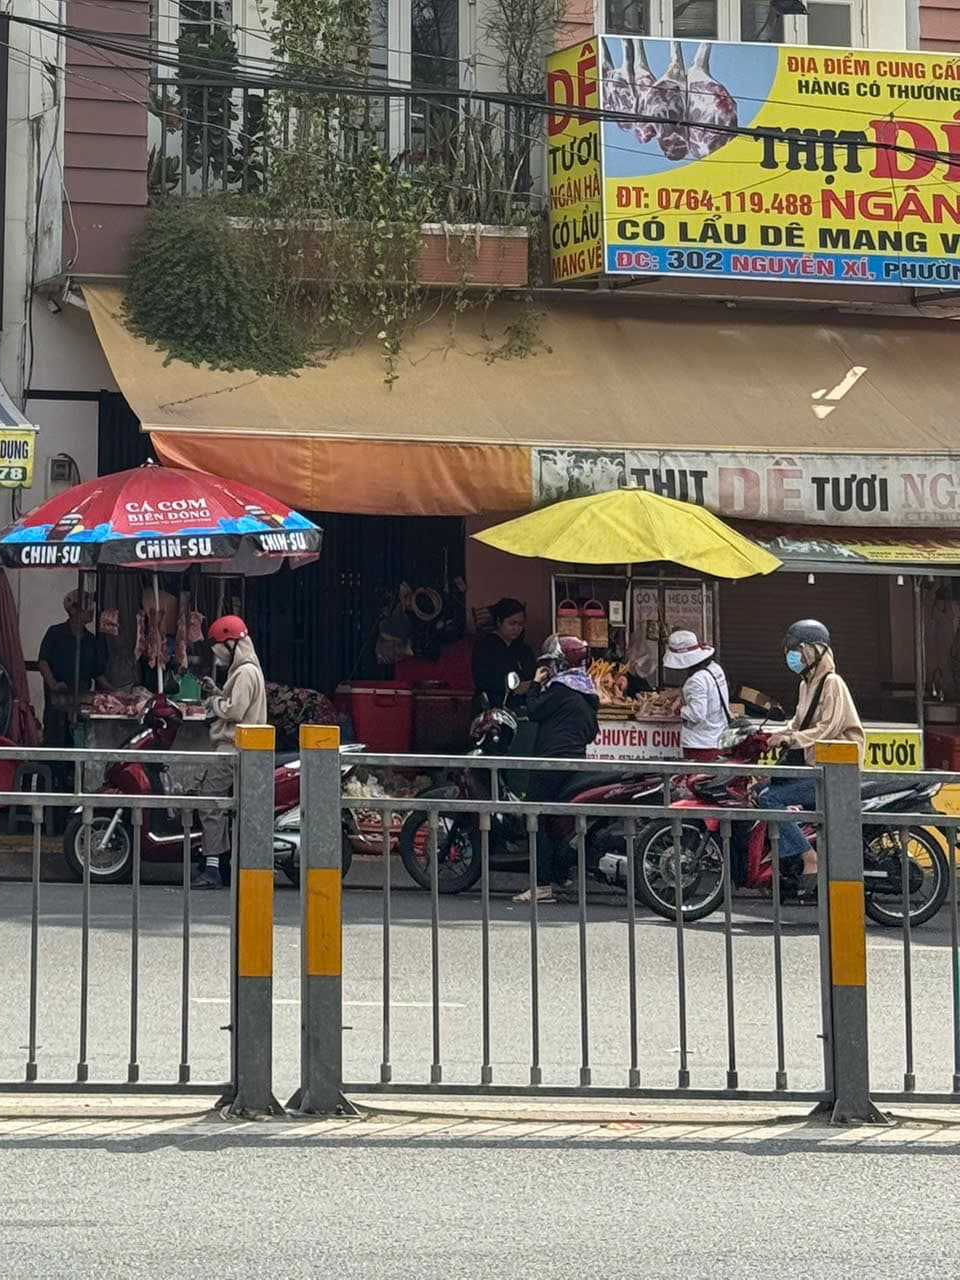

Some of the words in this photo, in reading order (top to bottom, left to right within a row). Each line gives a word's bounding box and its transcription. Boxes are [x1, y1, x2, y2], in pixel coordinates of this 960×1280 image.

[787, 56, 818, 76] ĐỊA
[824, 52, 870, 76] ĐIỂM
[876, 60, 926, 79] CUNG
[548, 43, 597, 136] DÊ
[798, 78, 849, 96] HÀNG
[856, 80, 881, 97] CÓ
[887, 84, 960, 101] THƯƠNG
[549, 133, 598, 175] TƯƠI
[756, 125, 868, 185] THỊT
[550, 176, 584, 210] NGÂN
[584, 168, 601, 199] HÀ
[616, 186, 649, 209] ĐT:
[657, 188, 813, 216] 0764.119.488
[821, 185, 960, 224] NGÂN
[552, 216, 570, 250] CÓ
[573, 204, 599, 244] LẨU
[617, 216, 665, 241] CÓ
[679, 214, 746, 245] LẨU
[760, 222, 805, 248] DÊ
[819, 227, 927, 253] MANG
[552, 250, 587, 282] MANG
[587, 238, 602, 271] VỀ
[617, 251, 658, 269] ĐC:
[667, 250, 723, 271] 302
[732, 252, 834, 276] NGUYỄN
[842, 257, 875, 280] XÍ,
[0, 440, 29, 464] DỤNG
[718, 455, 804, 517] DÊ
[811, 474, 889, 512] TƯƠI
[21, 545, 81, 565] CHIN-SU
[135, 537, 212, 559] CHIN-SU
[868, 739, 915, 766] TƯƠI
